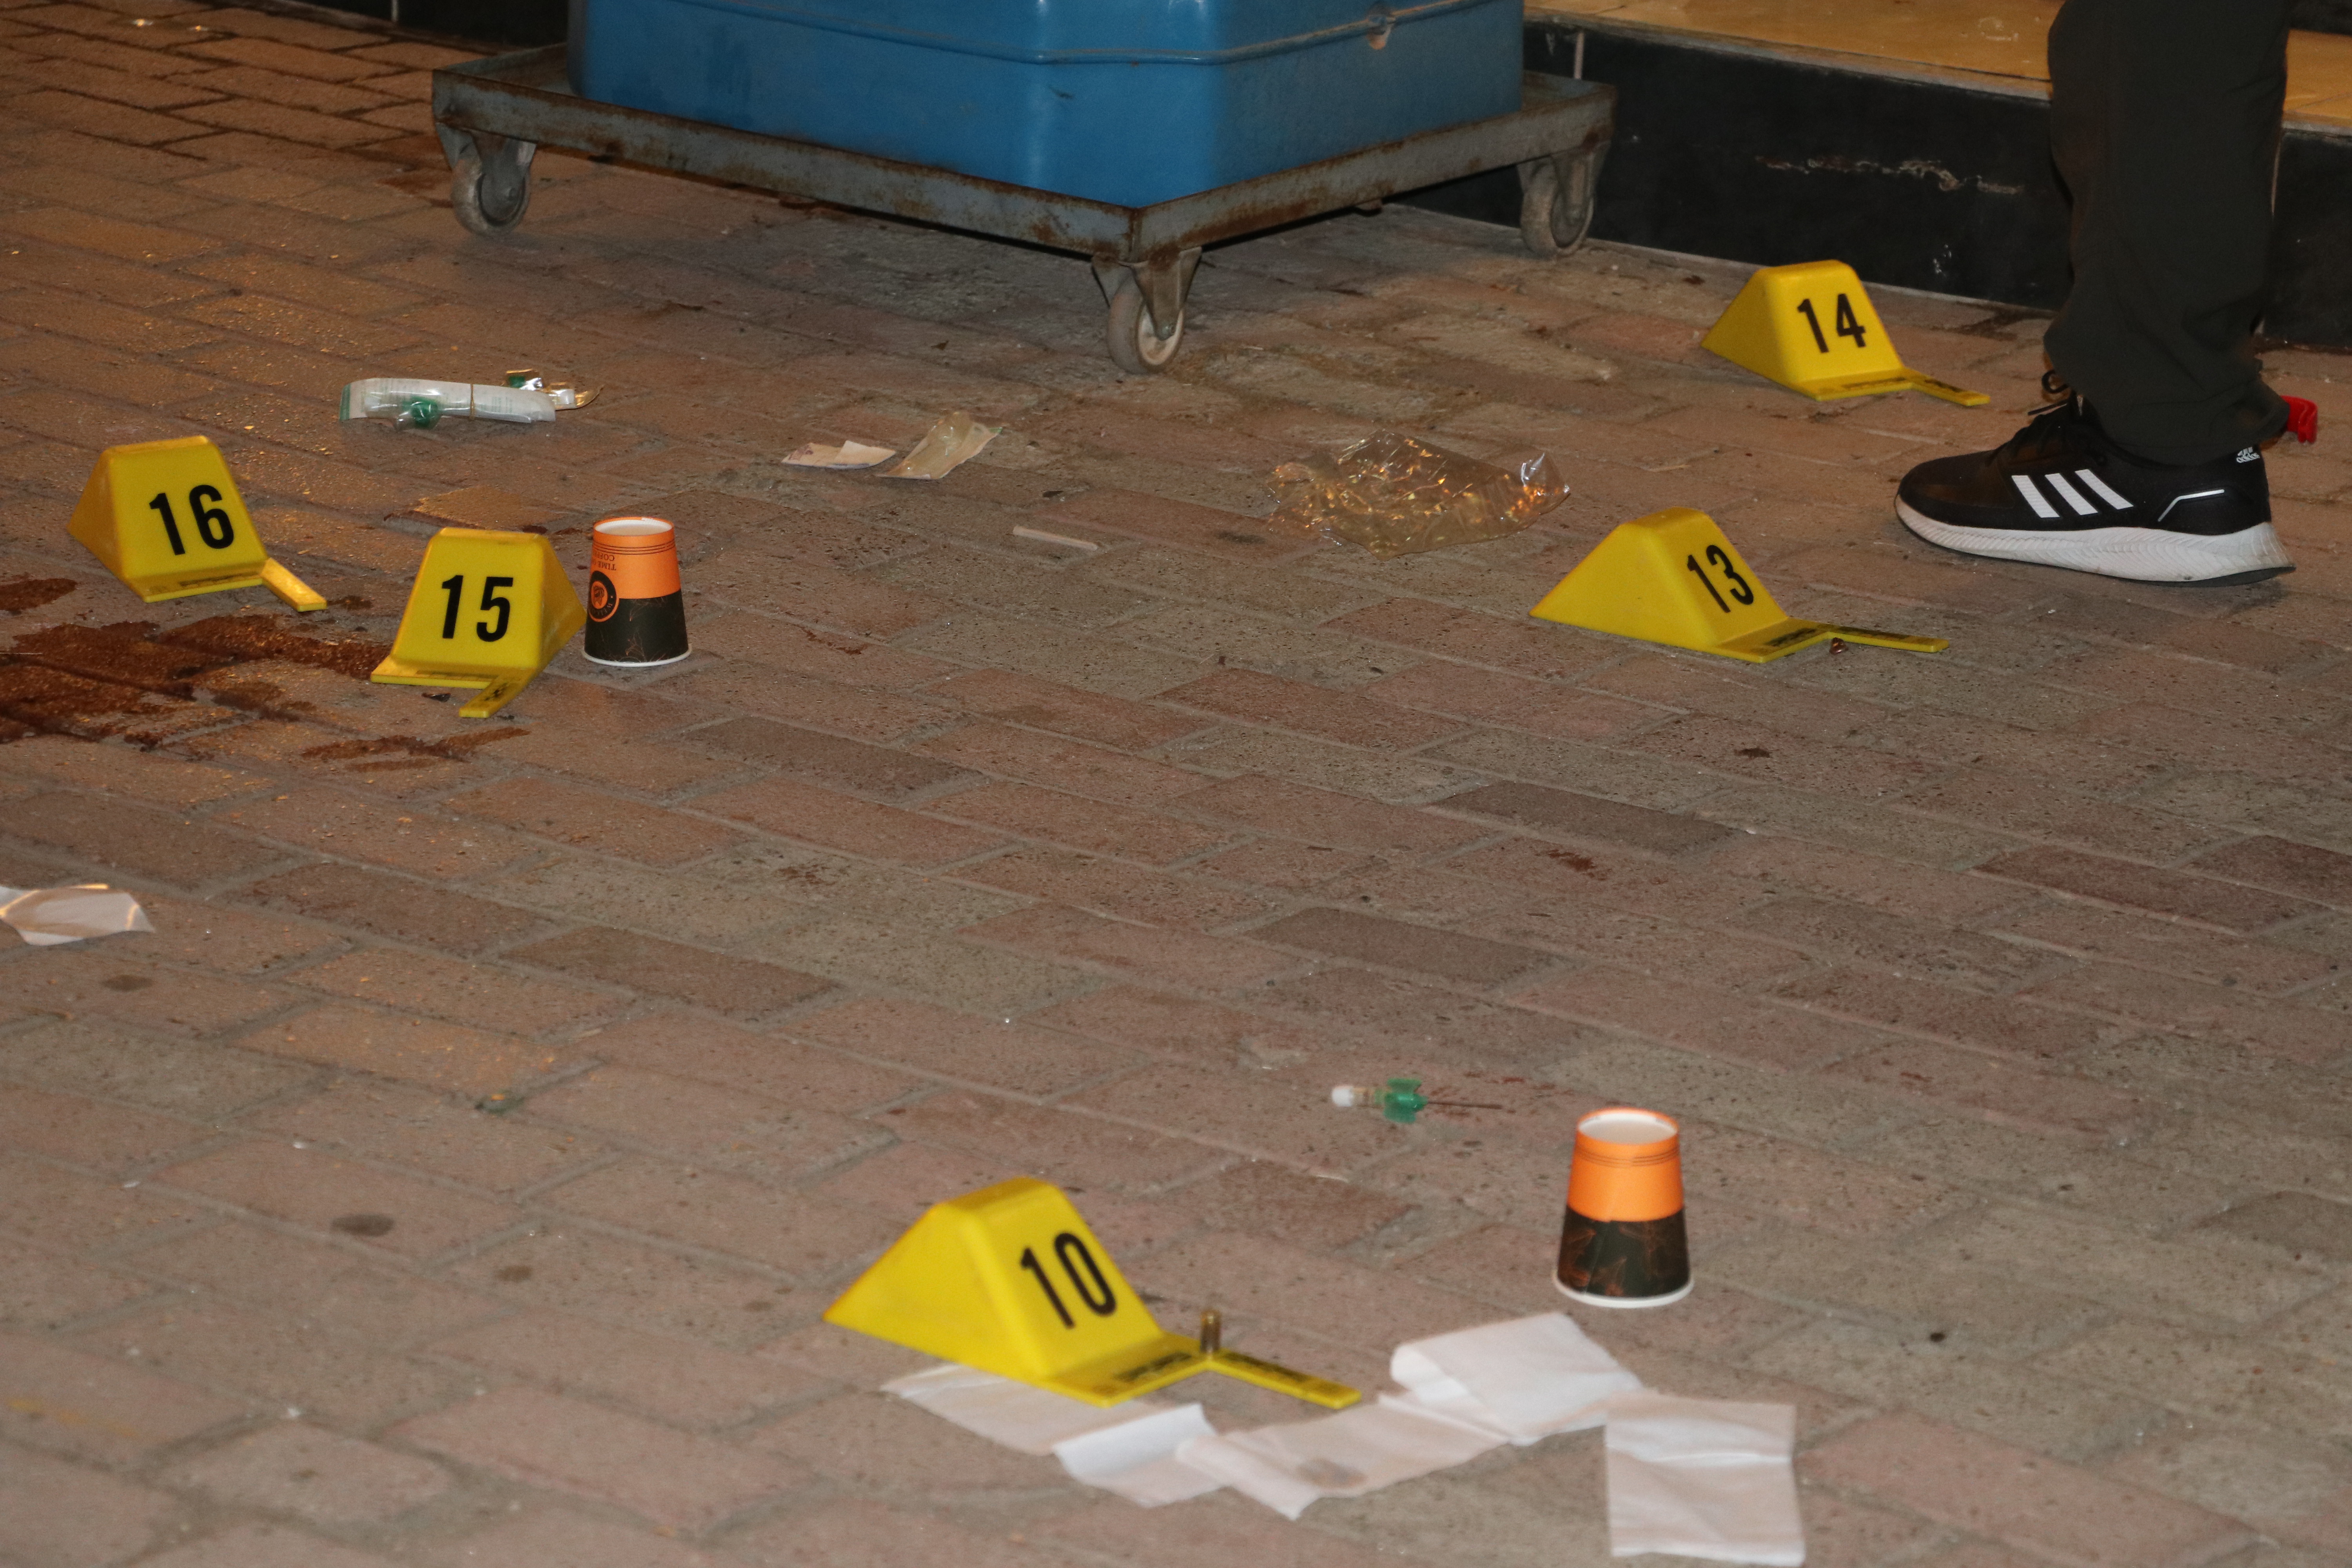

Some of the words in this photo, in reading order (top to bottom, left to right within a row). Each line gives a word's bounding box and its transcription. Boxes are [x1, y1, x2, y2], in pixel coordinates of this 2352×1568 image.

[1797, 293, 1866, 354] 14
[2236, 452, 2261, 463] adidas
[149, 484, 234, 555] 16
[598, 561, 616, 571] TIME
[1686, 544, 1755, 613] 13
[441, 574, 514, 642] 15
[1020, 1232, 1116, 1327] 10
